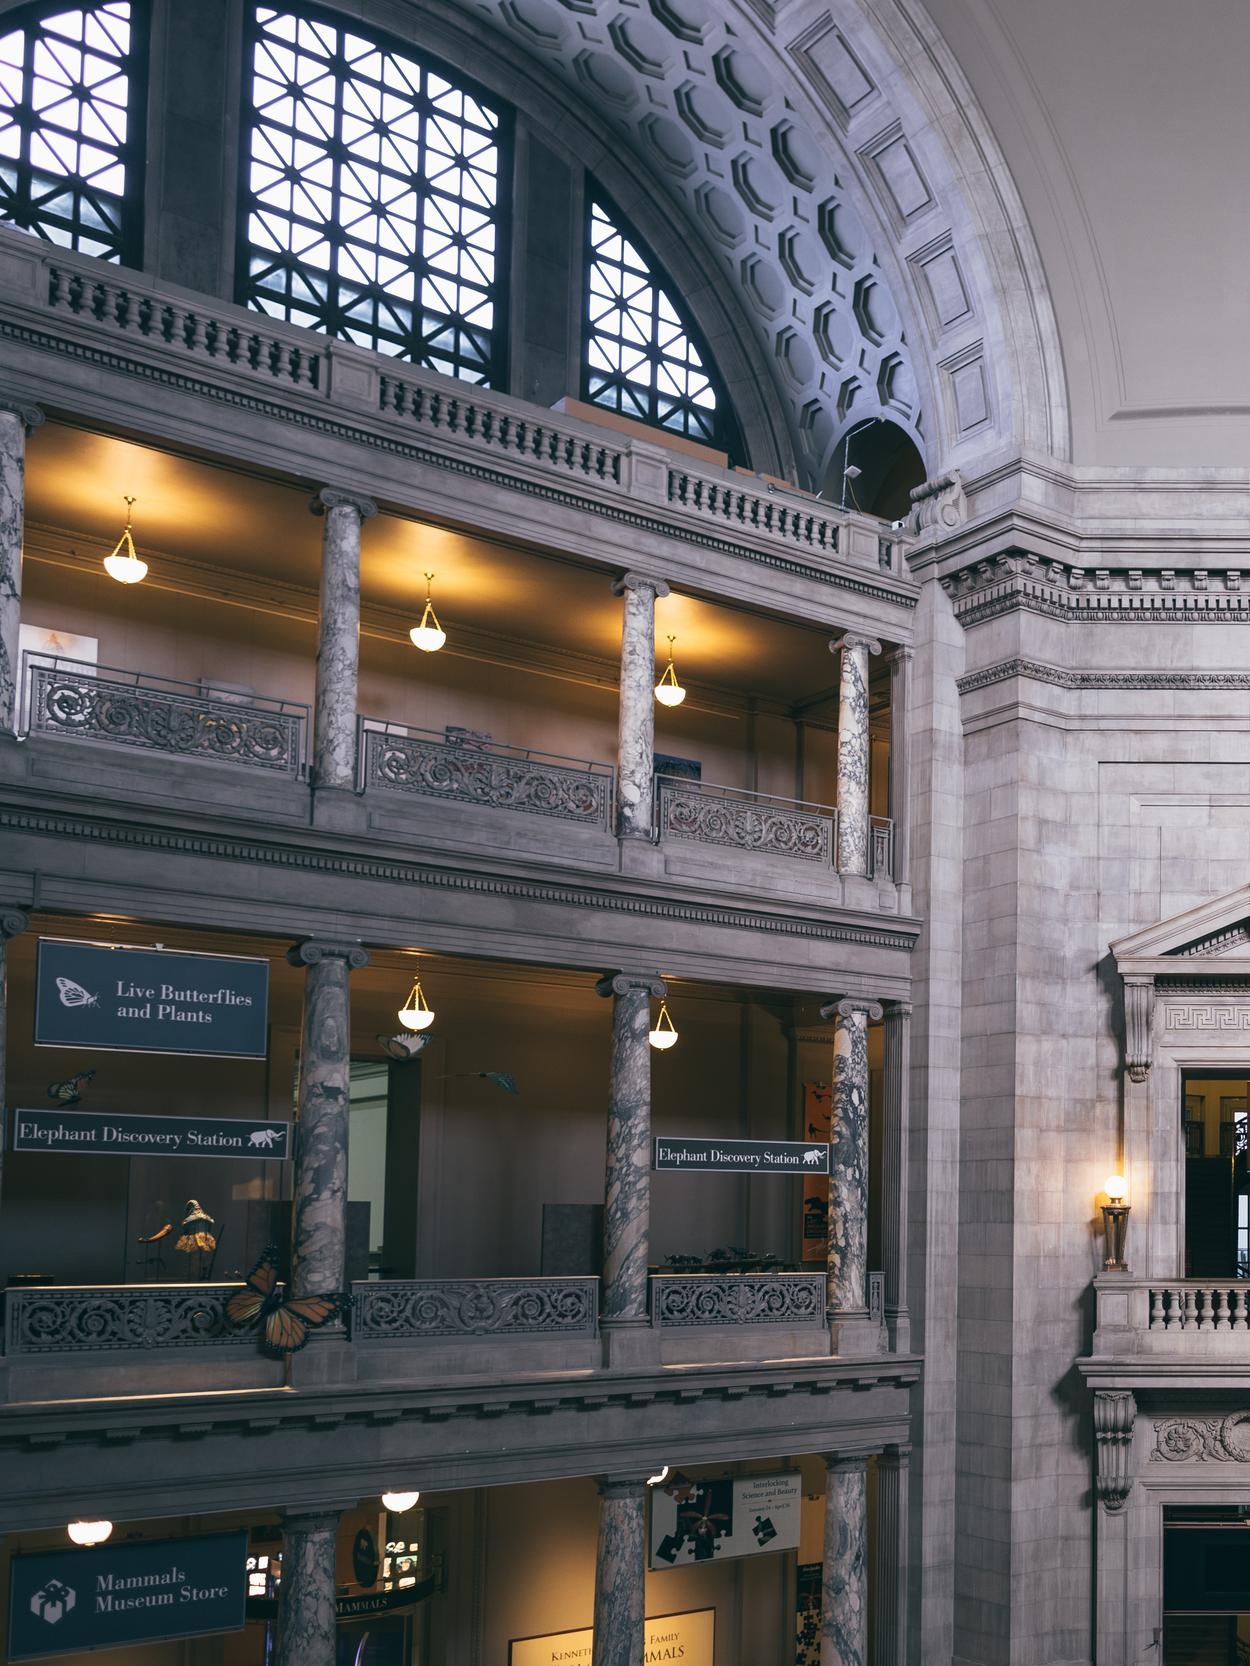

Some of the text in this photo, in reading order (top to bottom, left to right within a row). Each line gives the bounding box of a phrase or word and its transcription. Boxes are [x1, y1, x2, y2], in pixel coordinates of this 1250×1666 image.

[116, 981, 252, 1006] Live Butterflies
[117, 1004, 213, 1023] and Plants
[19, 1123, 242, 1149] Elephant Discovery Station
[658, 1148, 799, 1167] Elephant Discovery Station
[96, 1567, 186, 1592] Mammals
[95, 1585, 228, 1613] Museum Store
[650, 1632, 680, 1645] FAMILY
